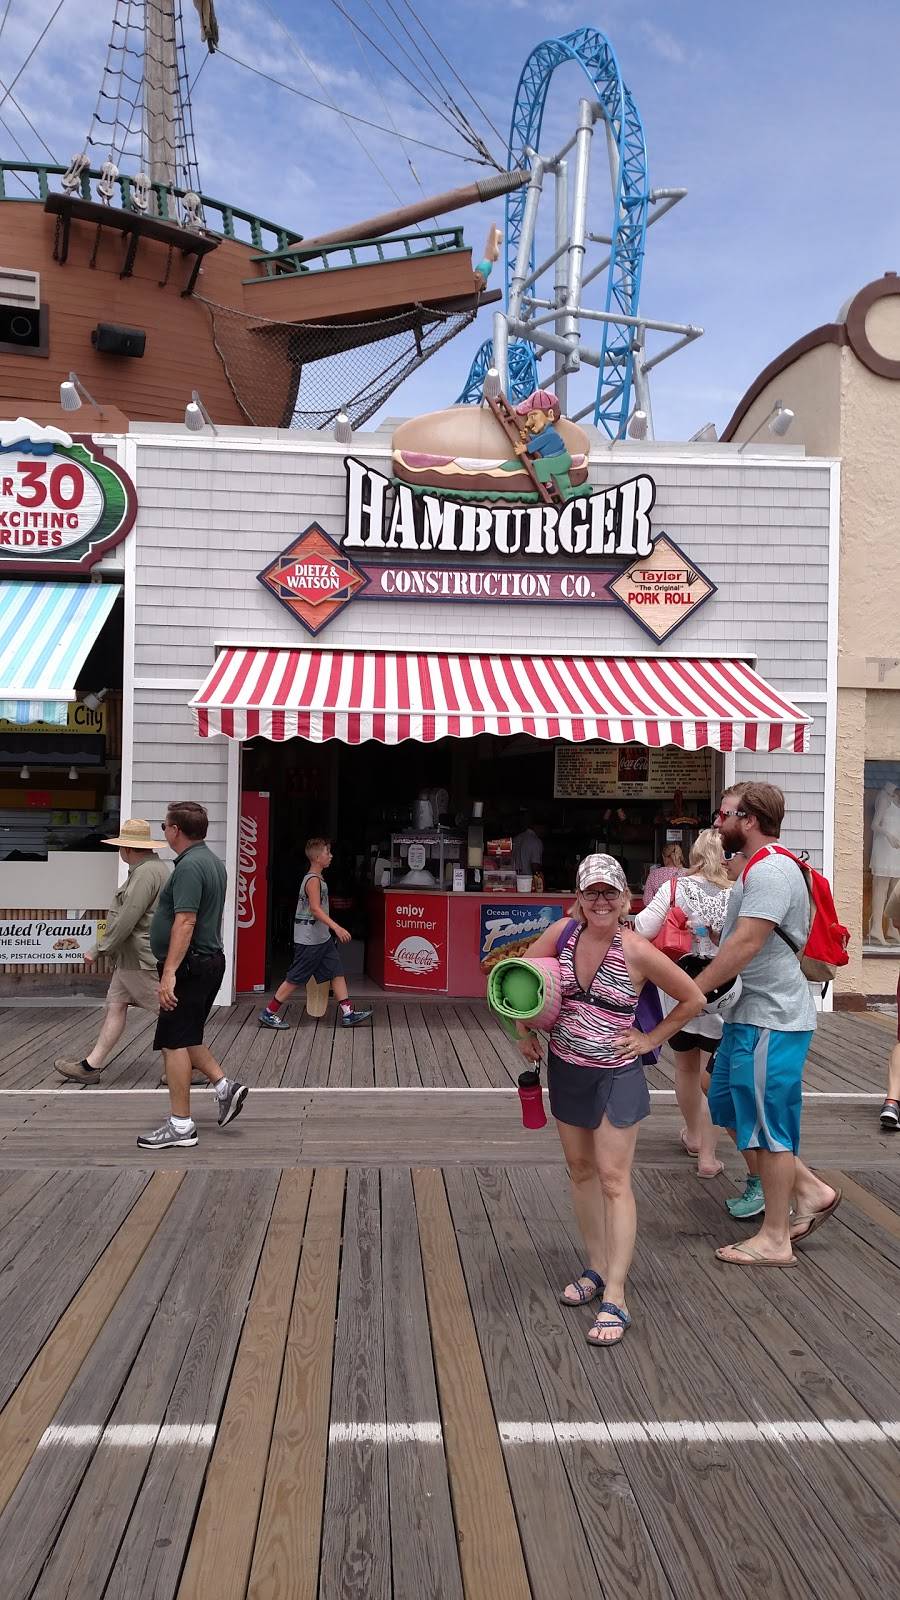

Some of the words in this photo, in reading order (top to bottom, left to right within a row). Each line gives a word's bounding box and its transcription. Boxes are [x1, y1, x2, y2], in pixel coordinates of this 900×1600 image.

[16, 461, 84, 510] 30
[342, 456, 655, 556] HAMBURGER
[0, 529, 63, 546] RIDES
[295, 564, 329, 577] DIETZ
[330, 566, 339, 577] &
[640, 571, 682, 583] Taylor
[287, 576, 340, 589] WATSON
[381, 570, 552, 597] CONSTRUCTION
[561, 574, 596, 598] CO.
[628, 592, 660, 605] PORK
[664, 592, 695, 605] ROLL
[74, 705, 103, 732] City
[396, 904, 425, 917] enjoy
[486, 908, 510, 916] Ocean
[35, 922, 92, 937] Peanuts
[396, 919, 437, 930] summer
[14, 938, 42, 946] SHELL
[10, 952, 56, 960] PISTACHIOS
[397, 947, 433, 966] Coca-Cola
